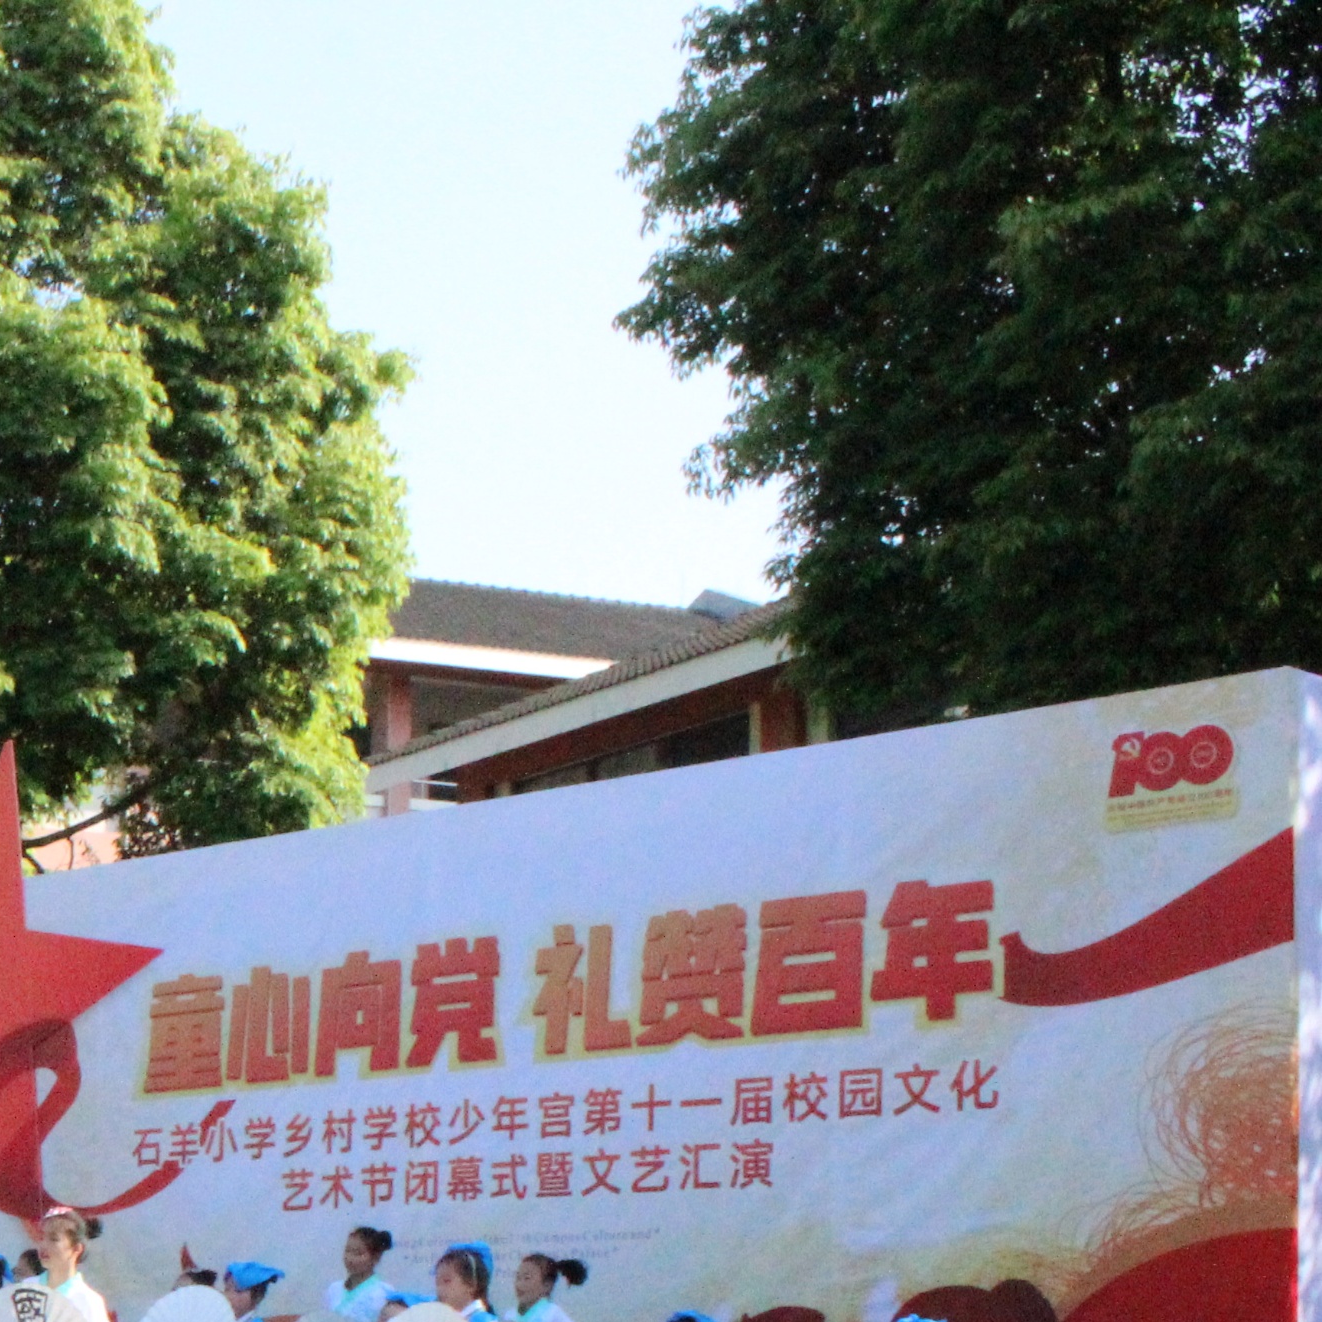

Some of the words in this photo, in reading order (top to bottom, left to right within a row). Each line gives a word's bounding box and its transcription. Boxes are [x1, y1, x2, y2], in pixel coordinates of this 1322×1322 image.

[143, 936, 501, 1094] 童心向党
[532, 879, 994, 1055] 礼赞百年
[132, 1059, 1000, 1168] 石羊小学乡村学校少年宫第十一届校园文化
[281, 1138, 775, 1212] 艺术节闭幕式暨文艺汇演
